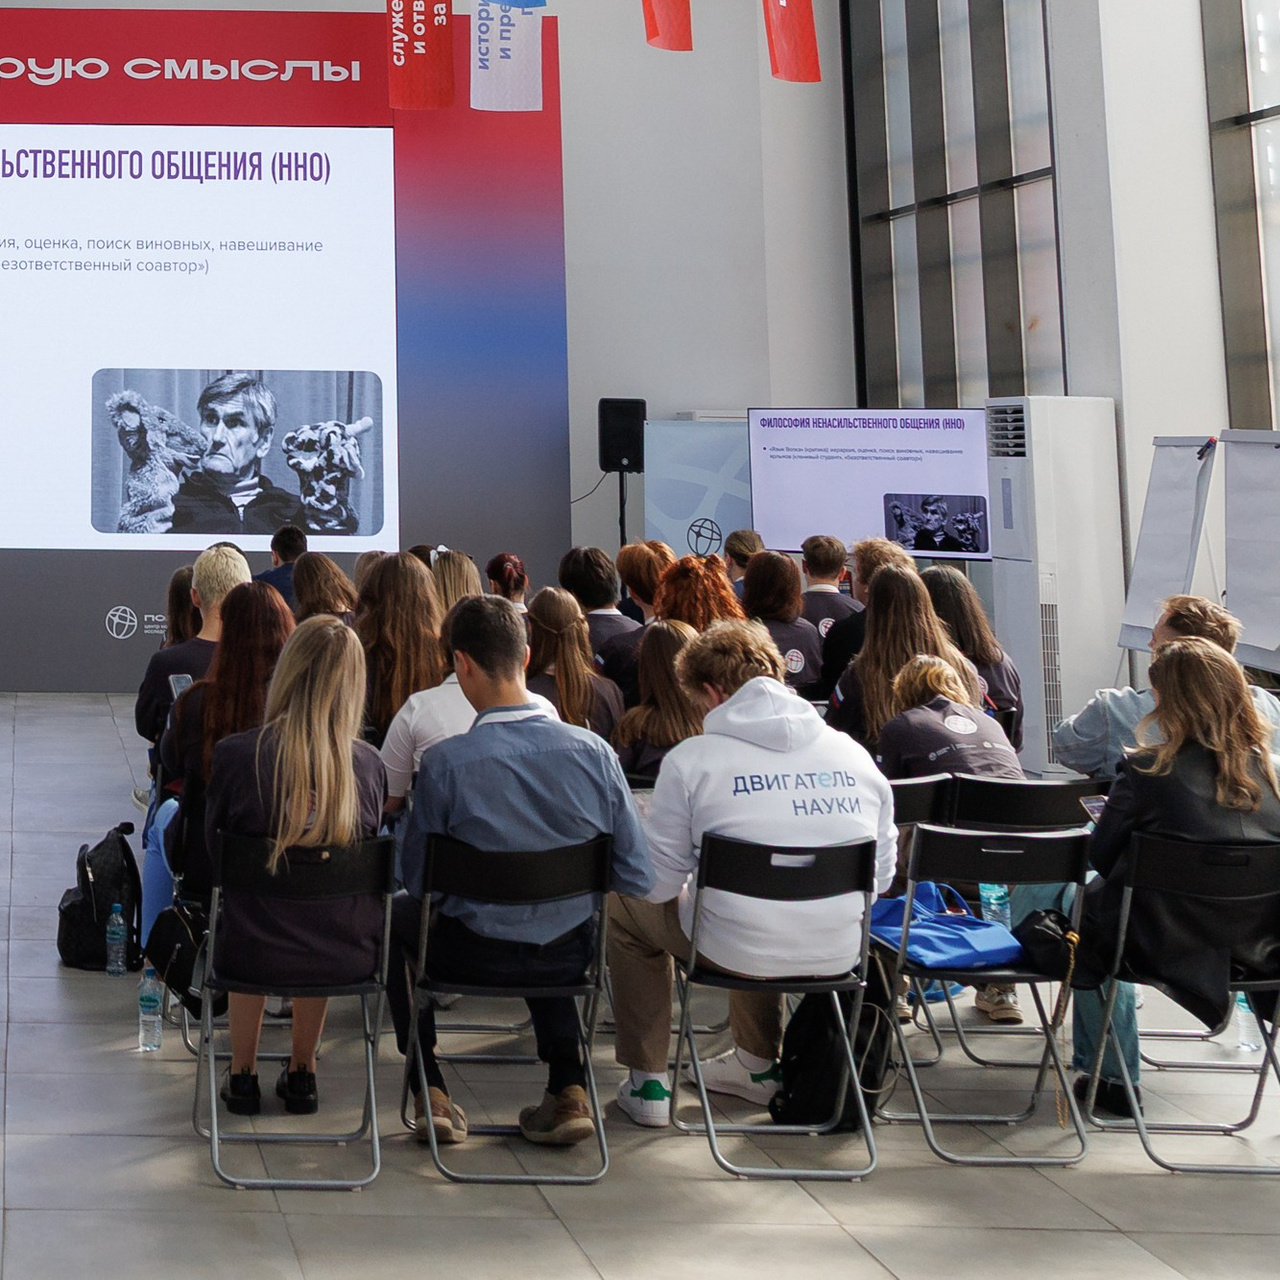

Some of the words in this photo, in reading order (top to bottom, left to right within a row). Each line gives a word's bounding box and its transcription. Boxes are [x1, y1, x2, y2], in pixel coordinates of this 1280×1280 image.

[433, 8, 447, 26] за
[413, 41, 426, 55] и
[123, 58, 361, 82] смыслы
[151, 150, 262, 184] ОБЩЕНИЯ
[270, 151, 331, 185] (ННО)
[24, 238, 82, 251] оценка,
[87, 239, 131, 250] поиск
[136, 240, 215, 252] виновных,
[220, 240, 324, 252] навешивание
[136, 259, 209, 275] соавтор»)
[759, 417, 811, 429] ФИЛОСОФИЯ
[812, 418, 898, 429] НЕНАСИЛЬСТВЕННОГО
[899, 418, 940, 430] ОБЩЕНИЯ
[942, 418, 965, 431] (ННО)
[792, 797, 862, 816] НАУКИ
